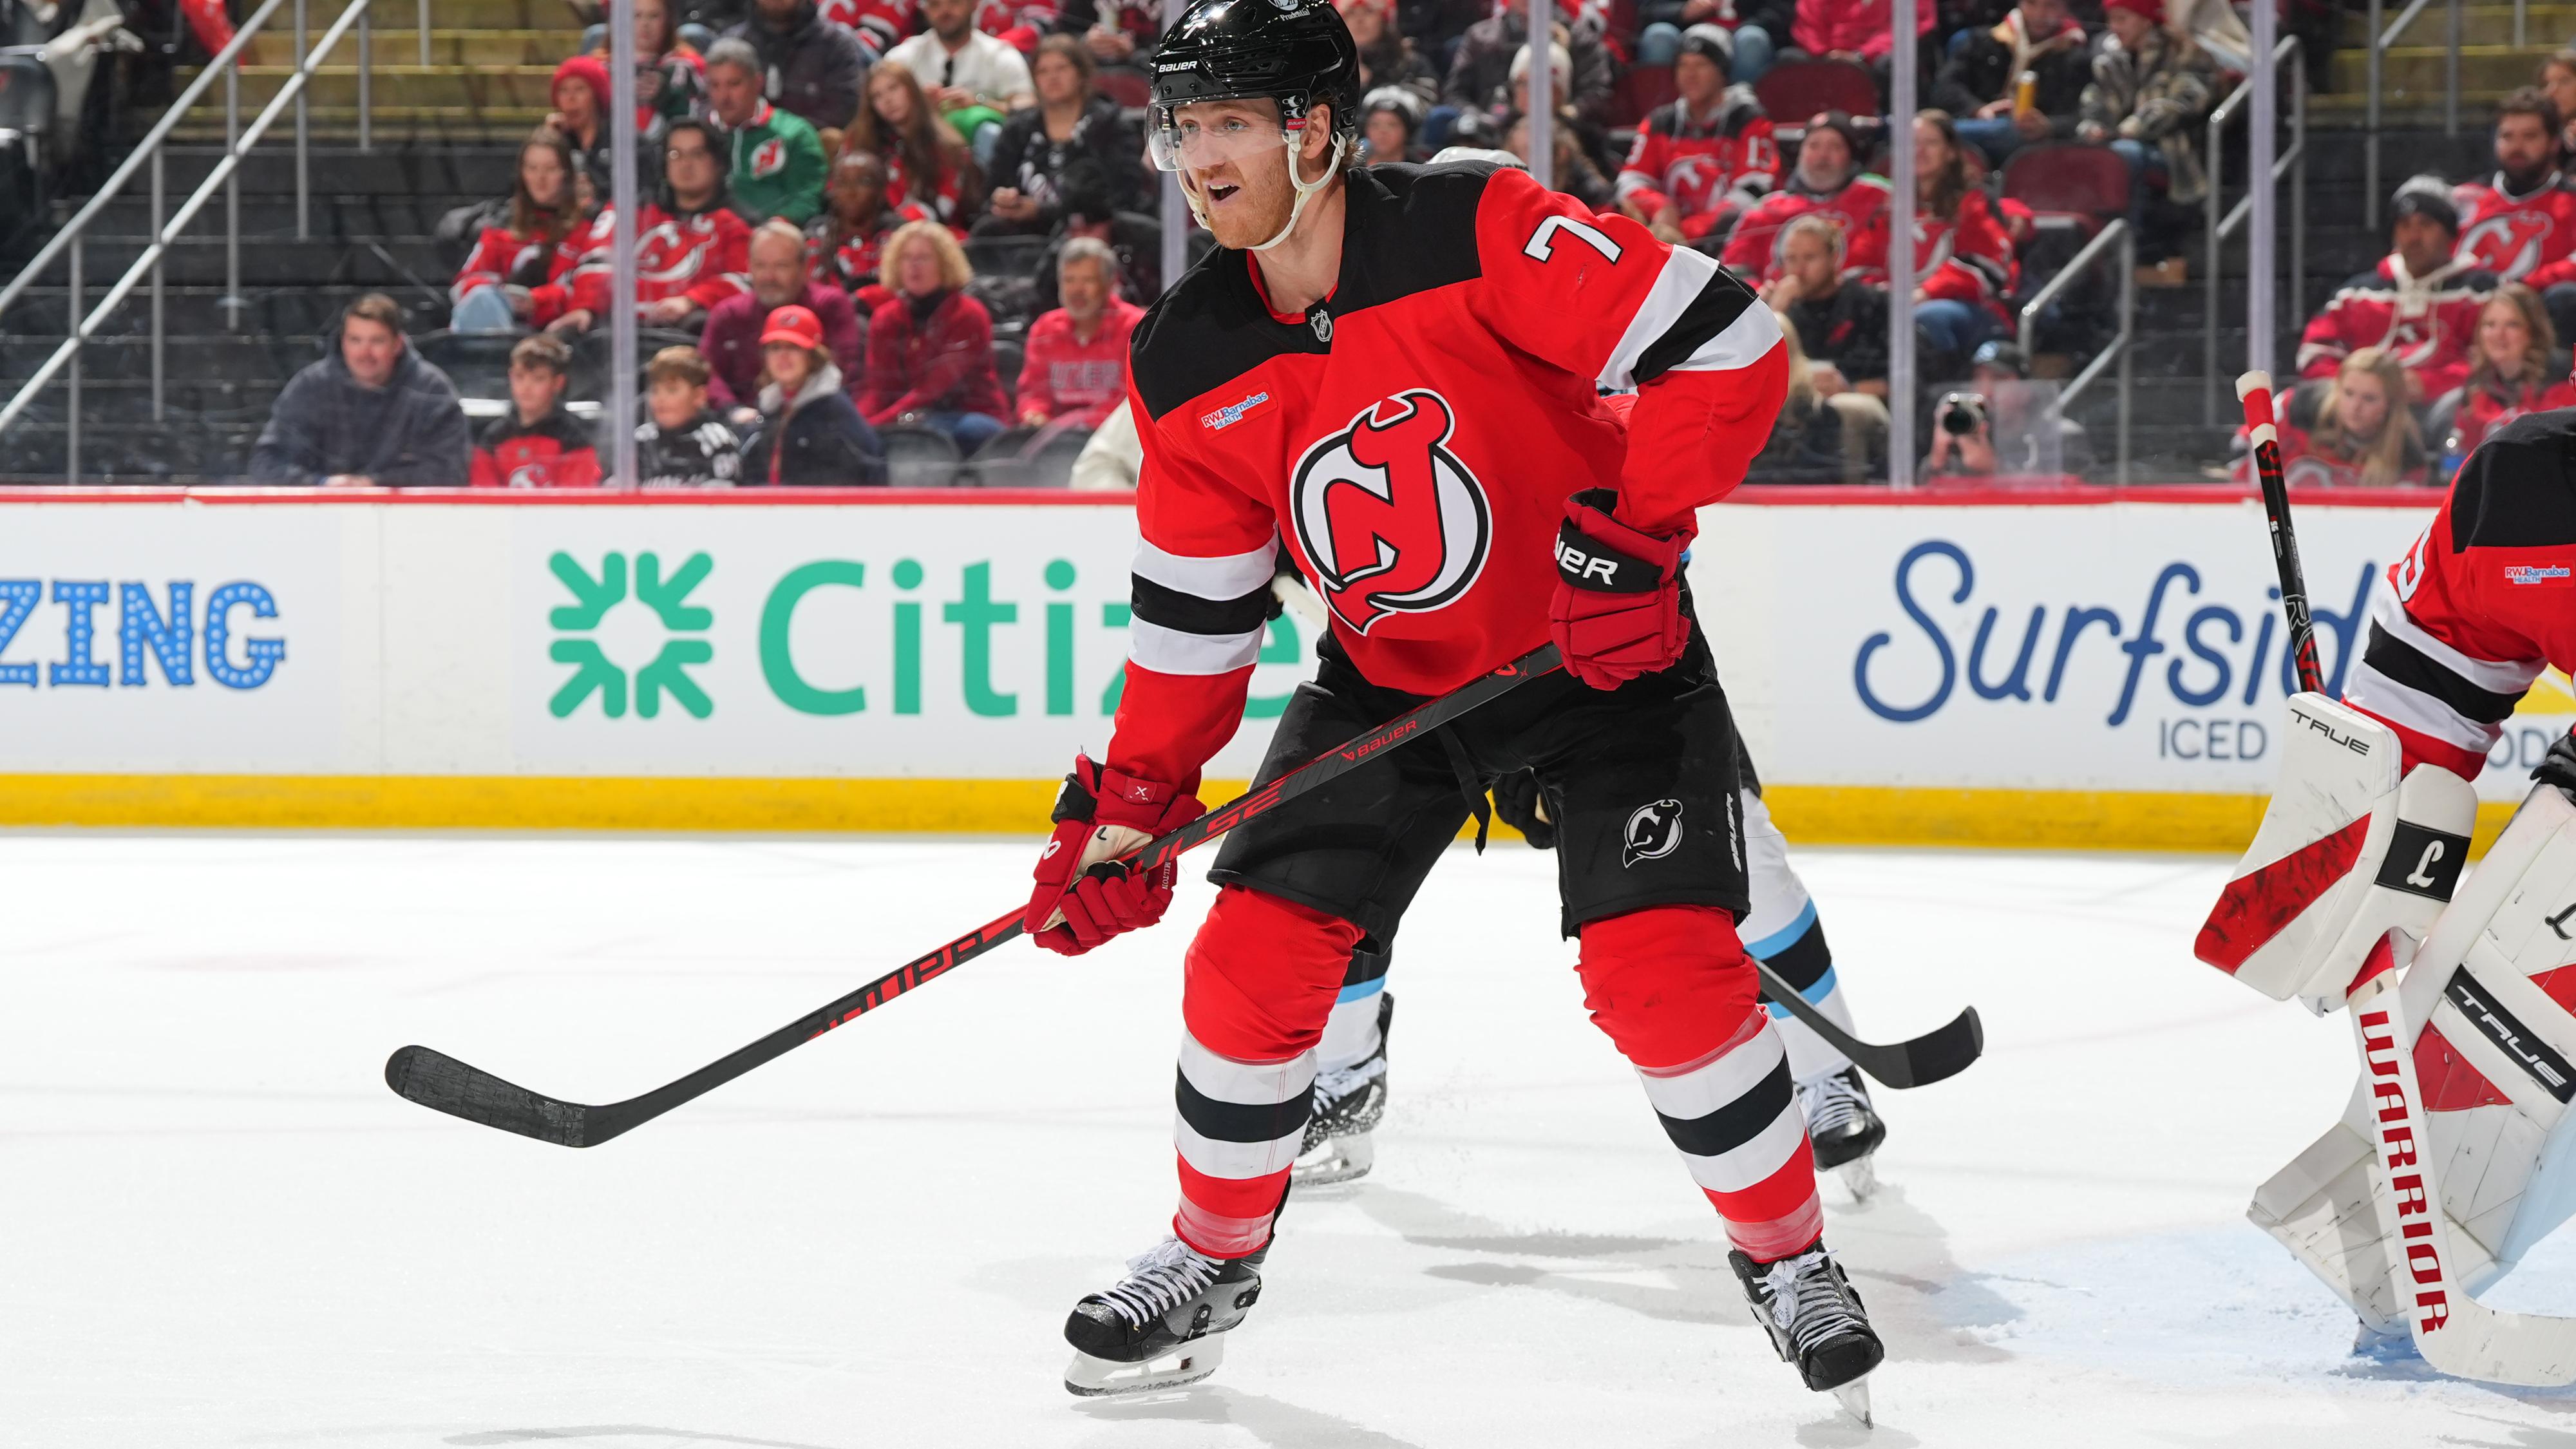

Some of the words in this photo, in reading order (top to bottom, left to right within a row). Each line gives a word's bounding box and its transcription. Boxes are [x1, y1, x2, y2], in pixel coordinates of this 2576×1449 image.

[1280, 8, 1310, 21] Prudential
[1524, 215, 1623, 265] 7
[1202, 392, 1268, 426] RWJBarnabas
[1215, 413, 1242, 429] HEALTH
[2506, 565, 2570, 578] RWJBarnabas
[0, 580, 285, 689] ZING
[2160, 720, 2267, 761] ICED
[2290, 709, 2370, 756] TRUE
[2456, 985, 2567, 1088] TRUE
[2360, 1010, 2448, 1336] WARRIOR
